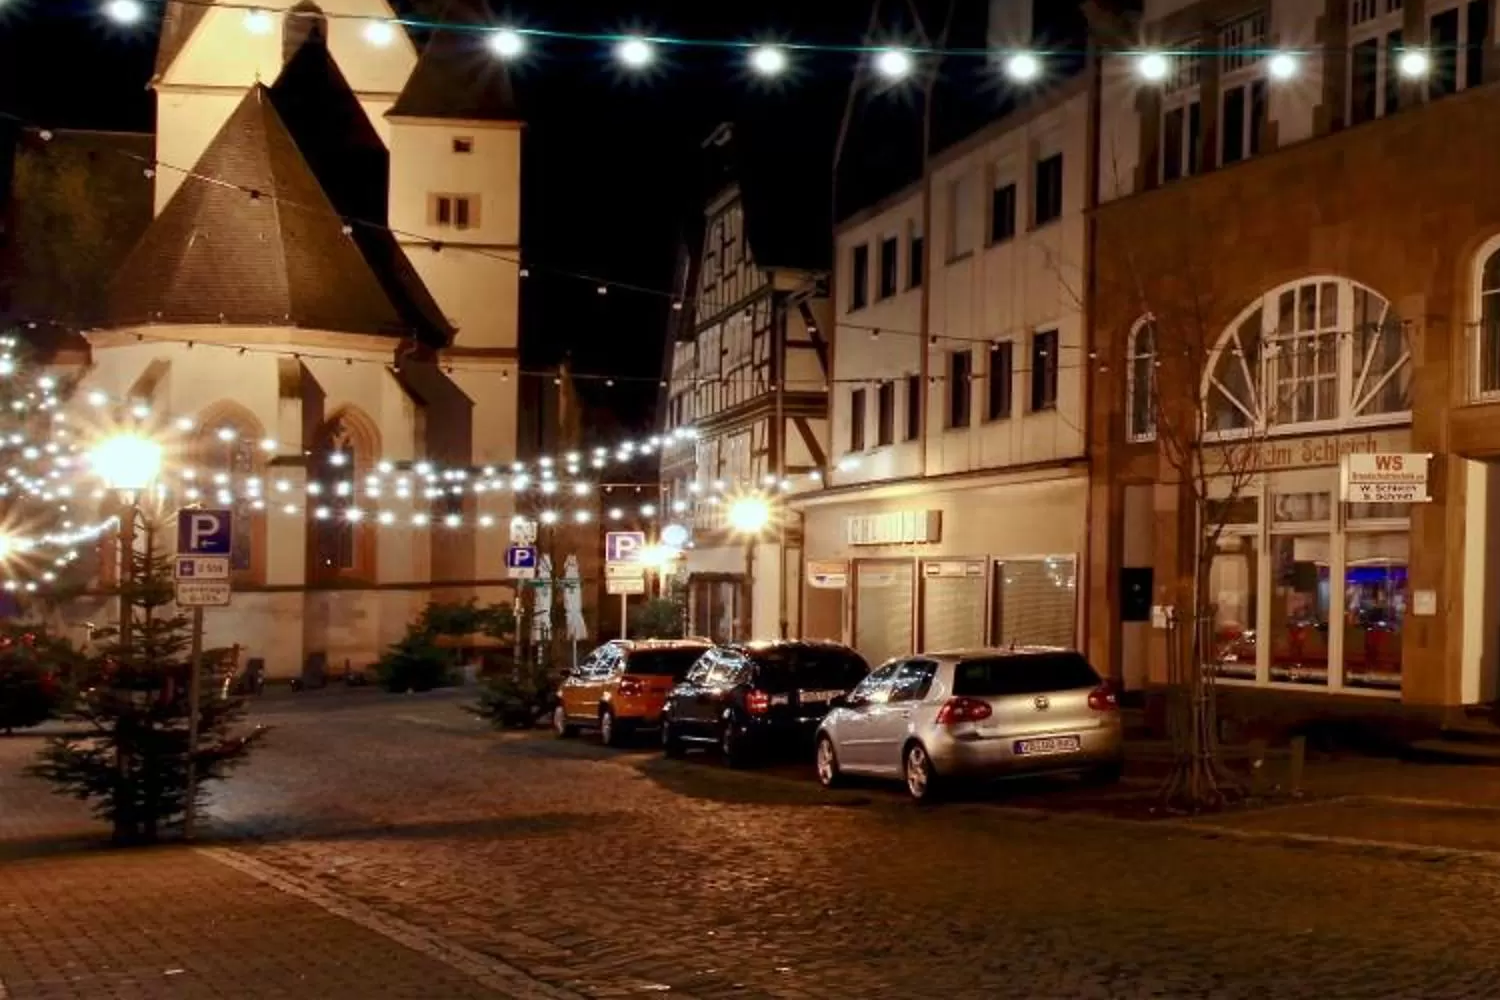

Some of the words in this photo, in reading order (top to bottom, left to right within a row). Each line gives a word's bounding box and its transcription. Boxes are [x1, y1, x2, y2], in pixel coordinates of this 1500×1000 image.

[1375, 455, 1403, 471] WS
[191, 514, 220, 549] P
[514, 549, 530, 566] P
[615, 536, 637, 559] P
